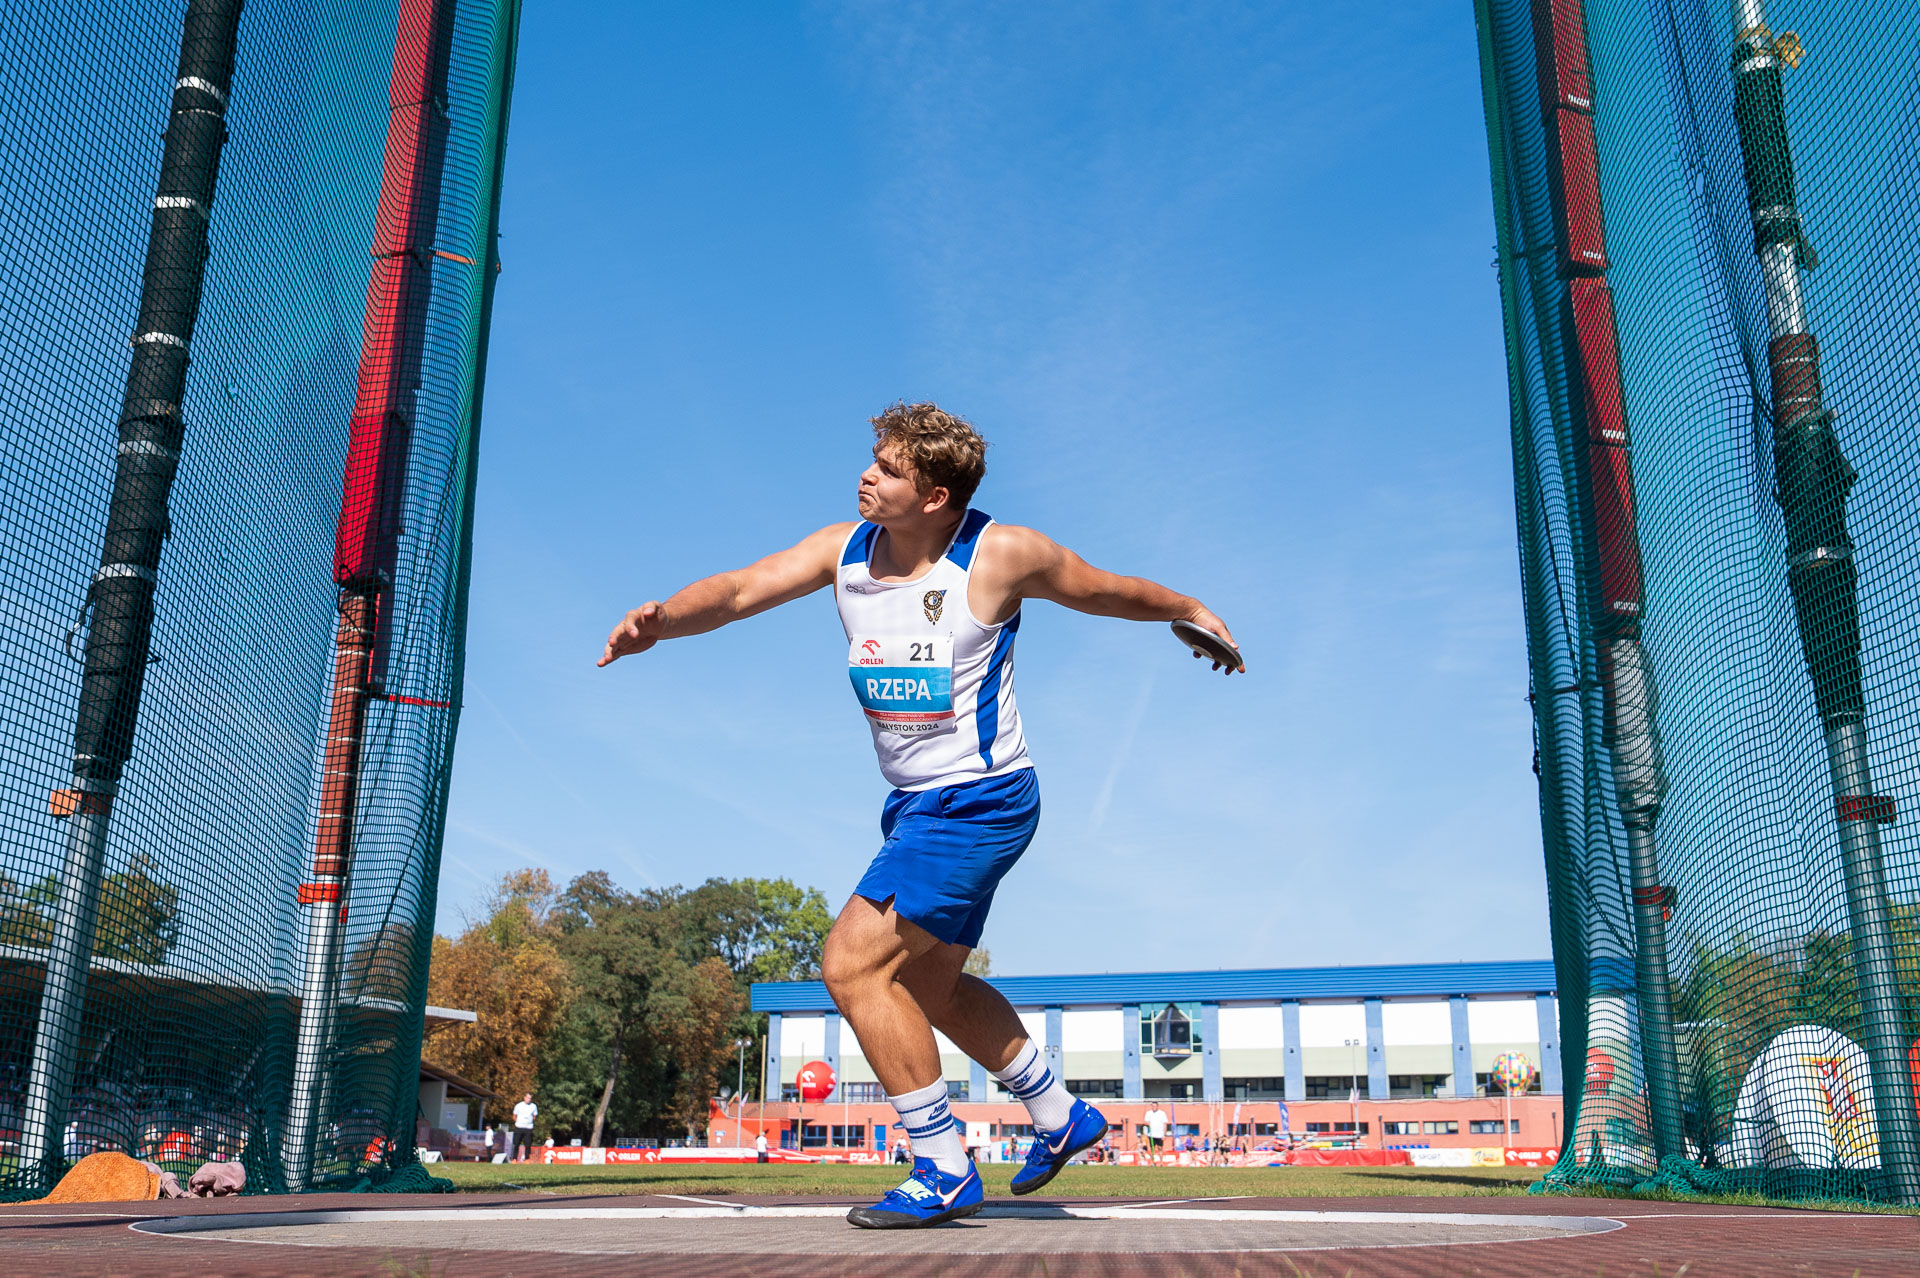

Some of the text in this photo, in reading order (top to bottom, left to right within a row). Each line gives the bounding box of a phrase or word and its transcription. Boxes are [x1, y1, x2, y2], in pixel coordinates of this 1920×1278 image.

[909, 642, 935, 662] 21
[866, 678, 932, 701] RZEPA
[916, 723, 939, 731] 2024
[849, 1152, 881, 1162] PZLA
[896, 1177, 936, 1202] NIKE
